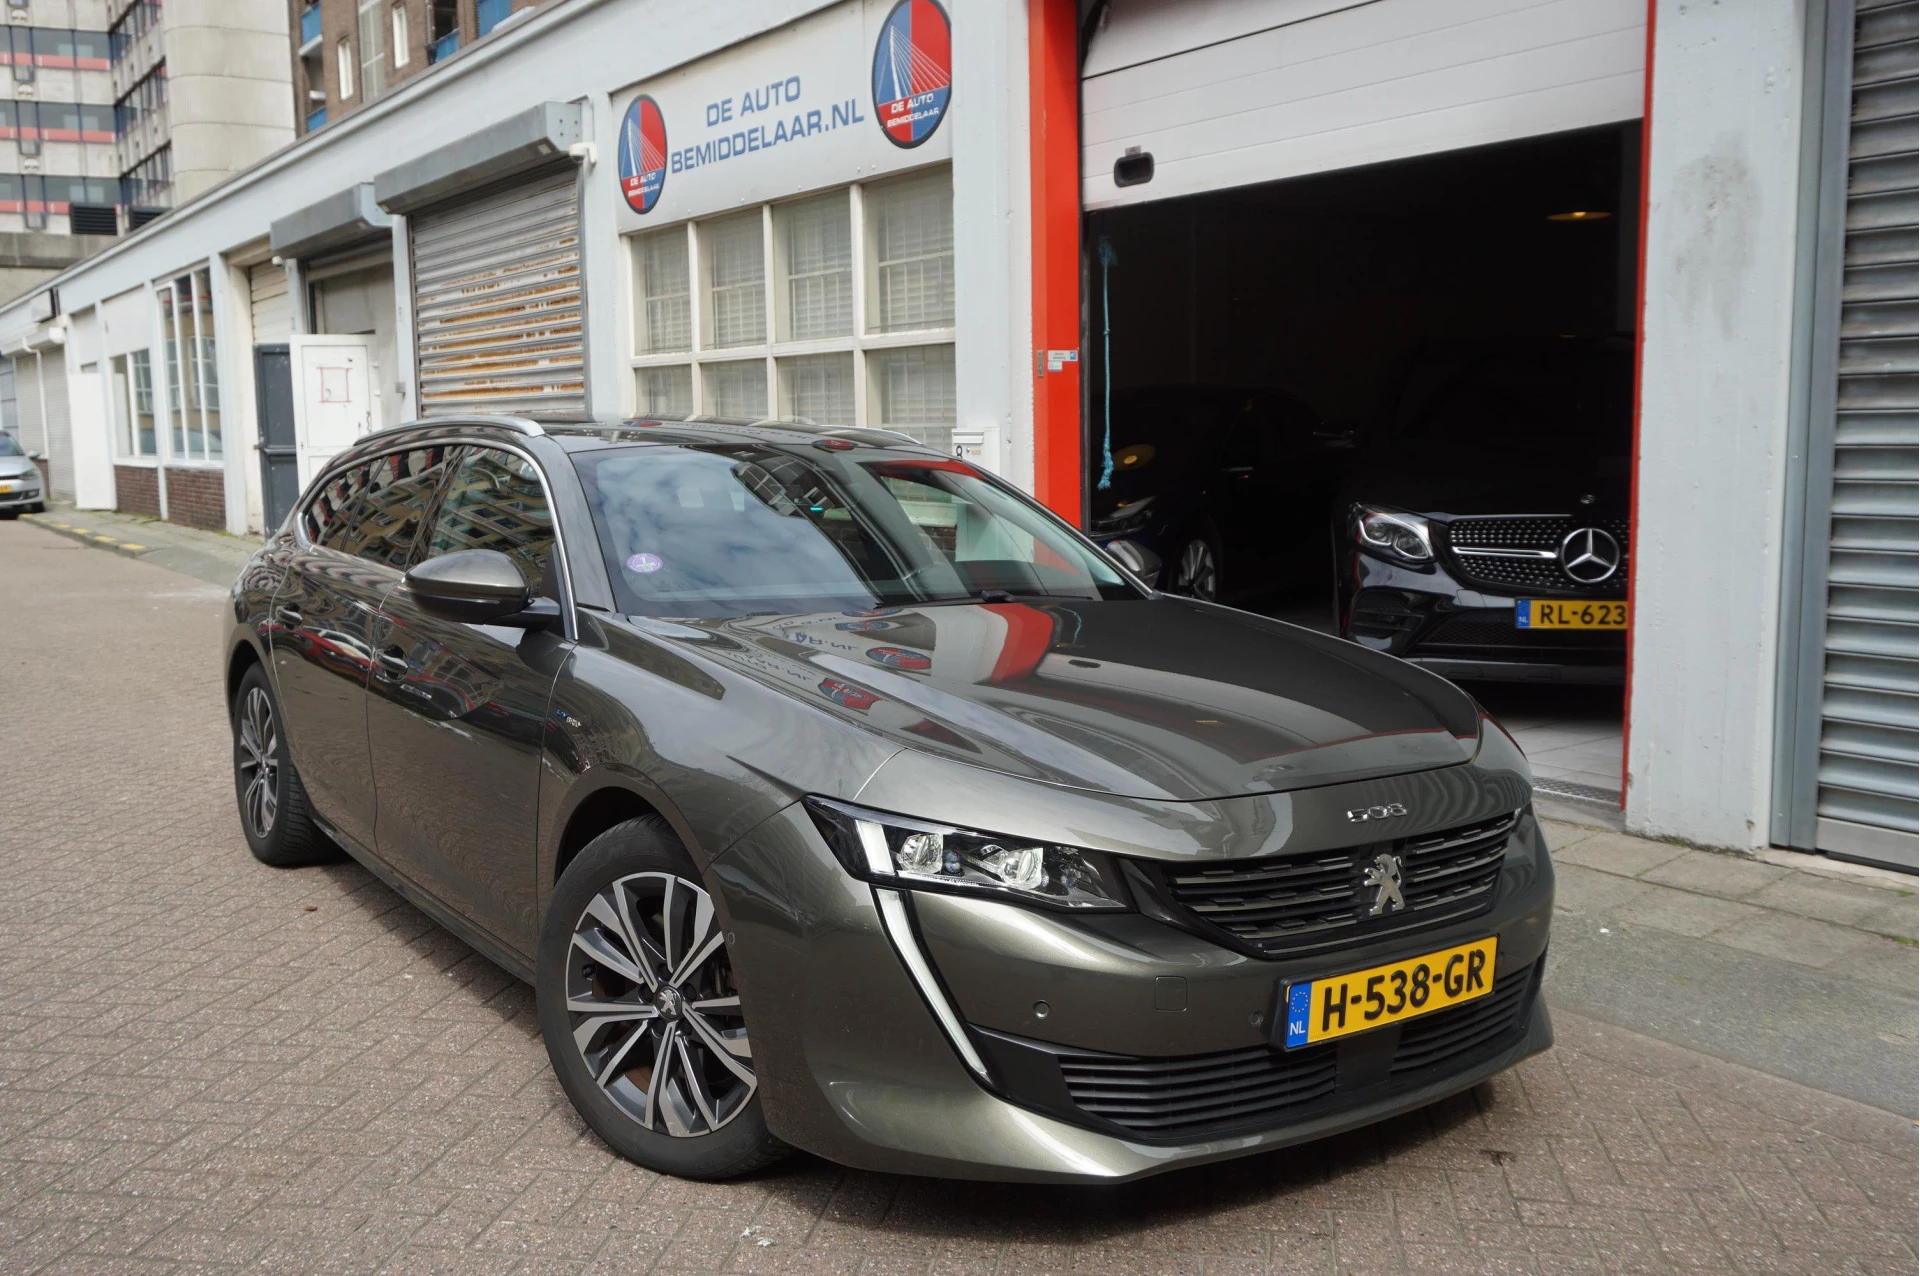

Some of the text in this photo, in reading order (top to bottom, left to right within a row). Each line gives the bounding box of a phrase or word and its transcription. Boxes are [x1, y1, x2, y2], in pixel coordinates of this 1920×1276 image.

[706, 75, 801, 127] DE AUTO
[887, 107, 940, 128] BEMIDDELAAR
[891, 93, 934, 114] DE AUTO
[671, 99, 865, 174] BEMIDDELAAR.NL
[1540, 604, 1627, 625] RL-623
[1290, 949, 1486, 1036] NL H-538-GR
